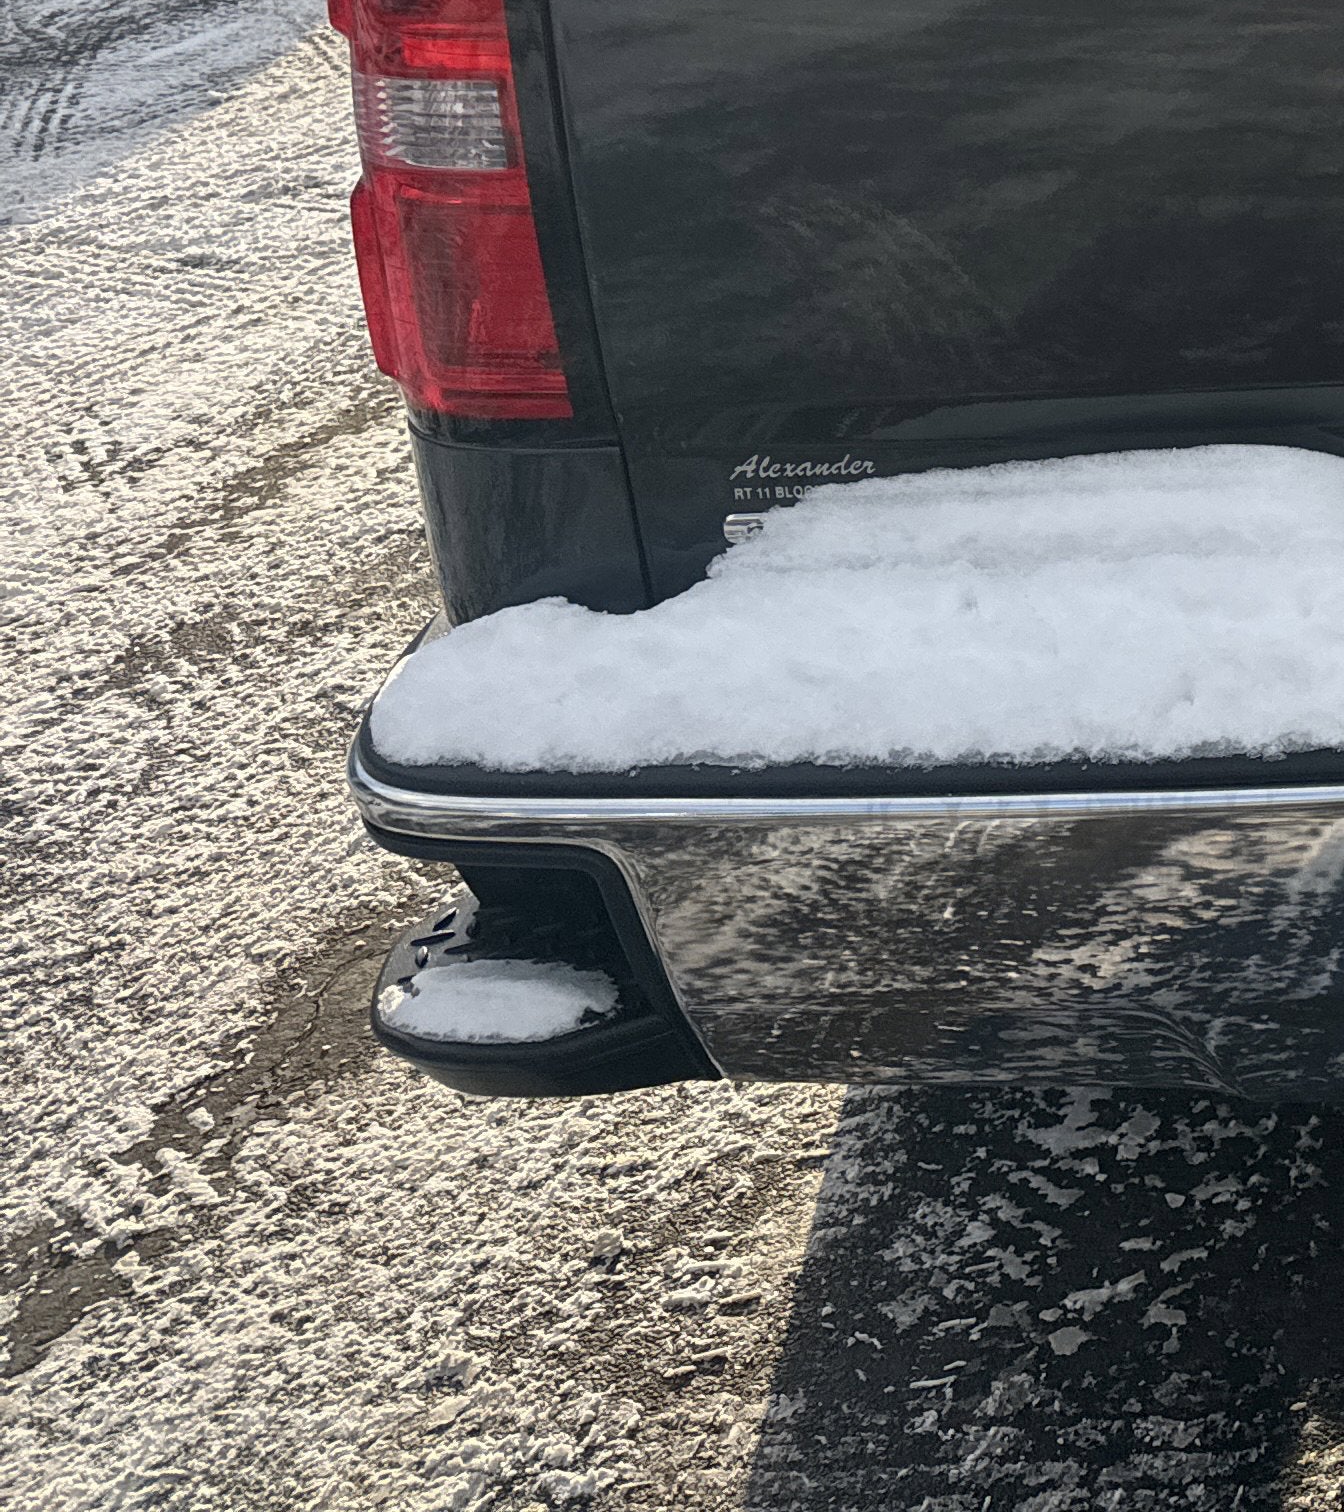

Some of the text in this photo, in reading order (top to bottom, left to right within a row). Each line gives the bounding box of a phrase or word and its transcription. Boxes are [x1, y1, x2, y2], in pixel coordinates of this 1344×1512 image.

[729, 454, 876, 480] Alexander
[734, 487, 753, 500] RT
[756, 487, 771, 499] 11
